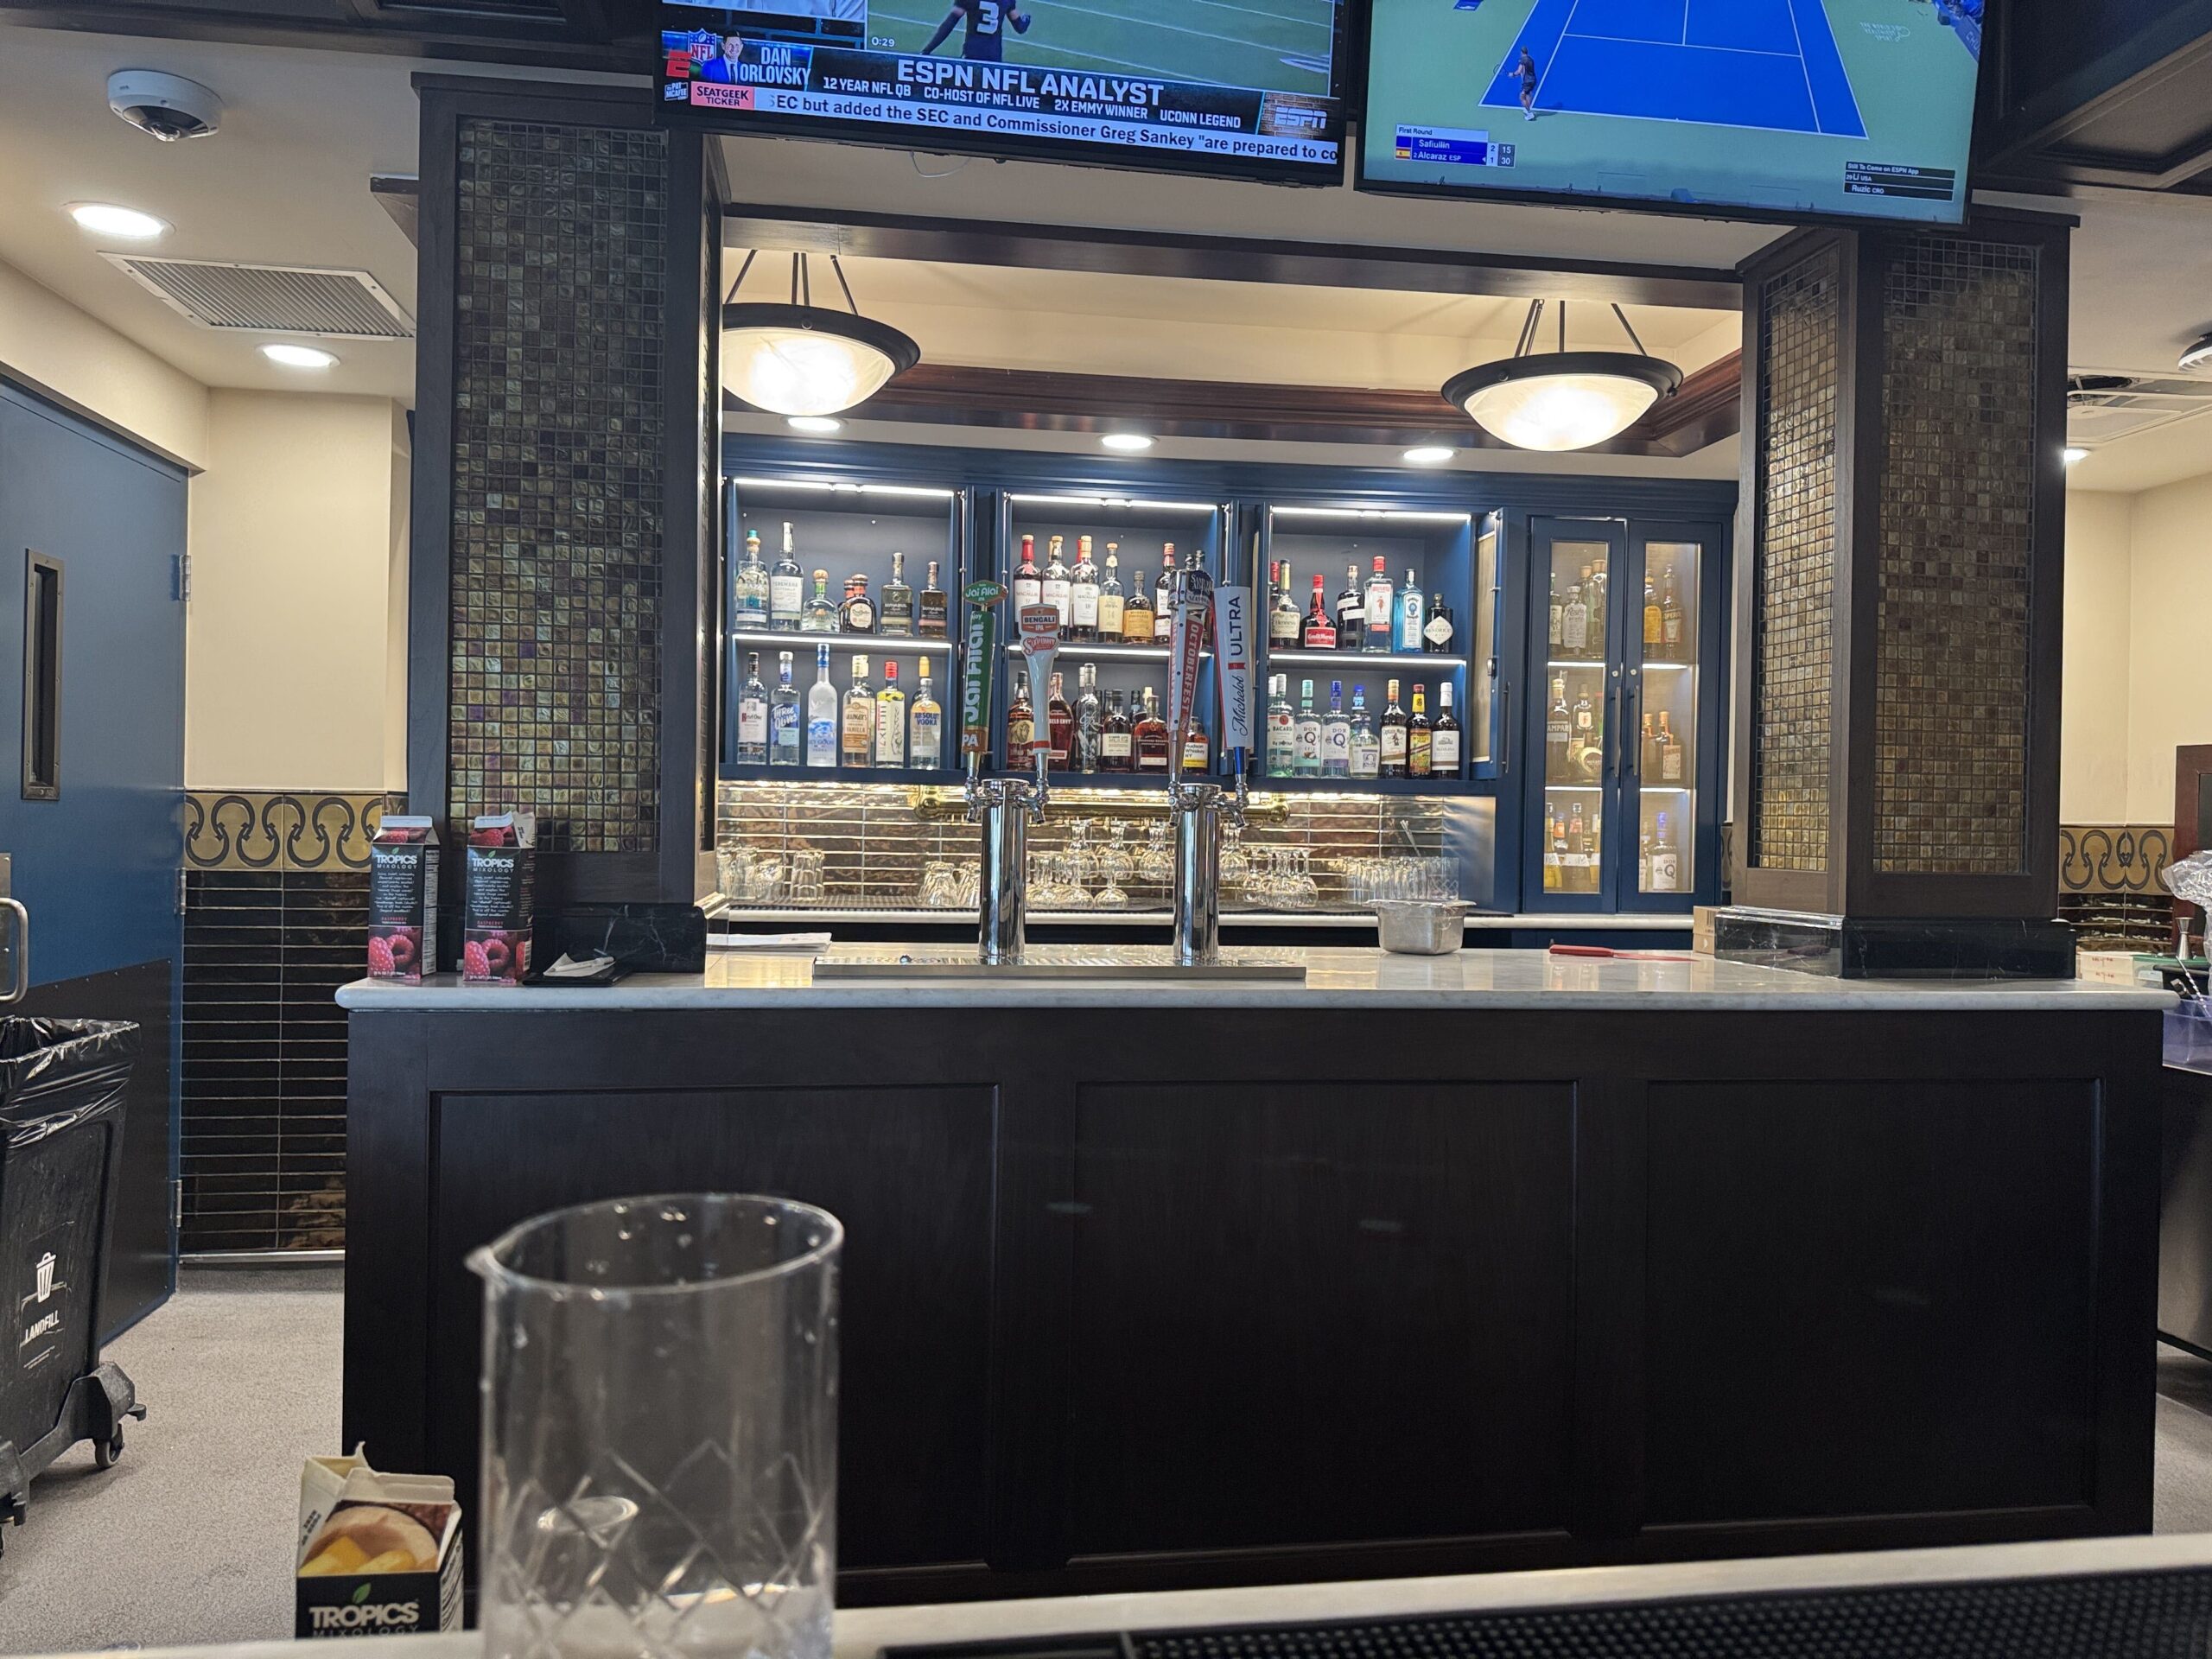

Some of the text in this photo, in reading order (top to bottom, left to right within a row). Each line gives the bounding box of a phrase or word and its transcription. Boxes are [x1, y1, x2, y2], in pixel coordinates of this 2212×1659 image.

[976, 1, 999, 35] 3
[871, 36, 895, 48] 0:29
[1965, 31, 1980, 55] CHU
[691, 44, 714, 60] NFL
[761, 47, 791, 67] DAN
[740, 64, 811, 86] ORLOVSKY
[898, 59, 1164, 105] ESPN NFL ANALYST
[696, 86, 749, 101] SEATGEEK
[706, 97, 740, 107] TICKER
[823, 76, 1241, 128] 12 YEAR NFL QB CO-HOST OF NFL LIVE 2X EMMY WINNER UCONN LEGEND
[1274, 106, 1327, 130] ESPN
[804, 97, 829, 112] but
[834, 101, 881, 118] added
[887, 105, 912, 119] the
[917, 108, 949, 124] SEC
[953, 112, 982, 127] and
[987, 114, 1096, 137] Commissioner
[1100, 125, 1137, 143] Greg
[1140, 129, 1194, 149] Sankey
[1198, 134, 1228, 149] "are
[1233, 140, 1297, 156] prepared
[1302, 145, 1316, 159] to
[1418, 139, 1451, 149] Safiullin
[1418, 151, 1447, 161] Alcaraz
[1852, 184, 1871, 193] Ruzic
[965, 587, 999, 598] Jai Alai
[1181, 623, 1199, 713] OCTOBERFEST
[1228, 596, 1249, 737] Michelob ULTRA
[1548, 724, 1569, 733] AMPAR
[962, 734, 978, 747] PA
[1304, 732, 1316, 746] Q
[1333, 733, 1345, 748] Q
[376, 855, 417, 865] TROPICS
[472, 858, 514, 868] TROPICS
[1664, 864, 1675, 880] Q
[24, 1310, 60, 1344] LANDFILL
[308, 1602, 420, 1629] TROPICS
[313, 1624, 418, 1638] MIXOLOGY
